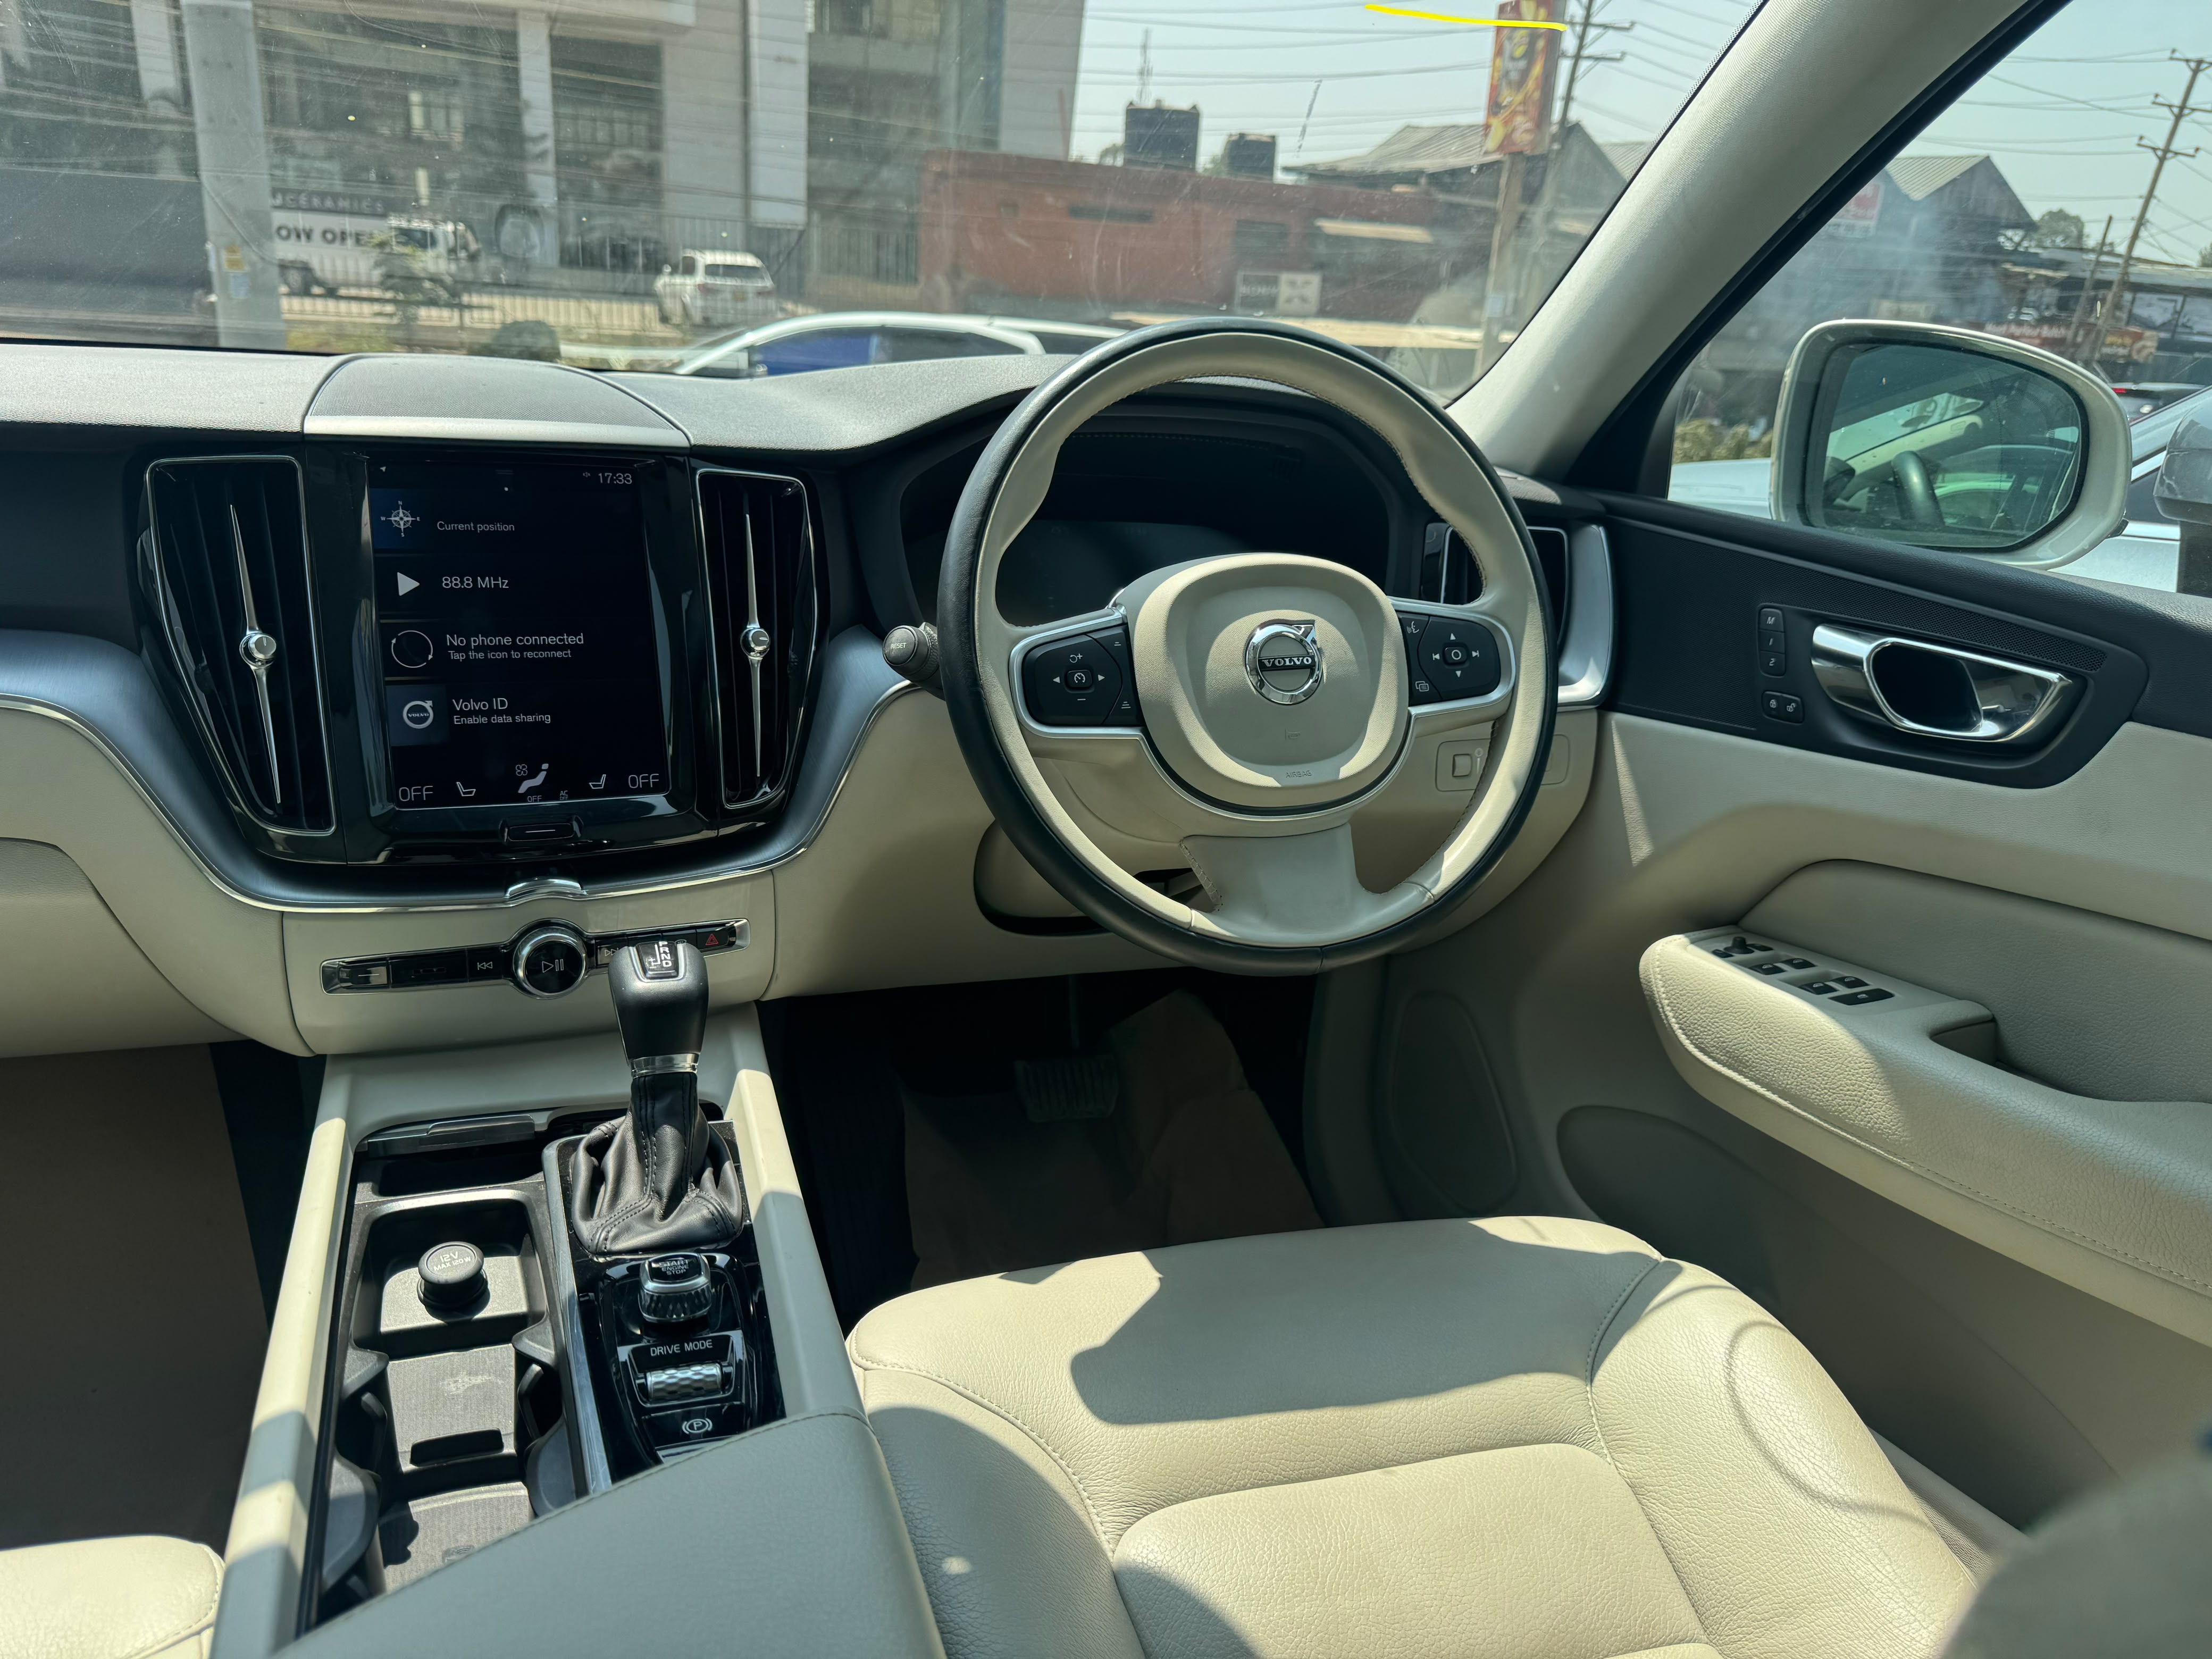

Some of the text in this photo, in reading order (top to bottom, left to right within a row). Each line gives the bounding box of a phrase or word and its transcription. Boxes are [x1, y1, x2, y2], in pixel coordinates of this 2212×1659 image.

[286, 192, 383, 212] CERAMICS
[276, 226, 370, 247] OW OPE
[598, 472, 633, 484] 17:33
[437, 521, 515, 533] Current position
[442, 576, 509, 589] 88.8 MHz
[447, 633, 584, 648] No phone connected
[448, 649, 572, 661] Tap the icon to reconnect
[1262, 657, 1312, 667] VOLVO
[453, 698, 508, 710] Volvo ID
[454, 713, 551, 724] Enable data sharing
[629, 774, 659, 788] OFF
[399, 786, 433, 801] OFF
[440, 1251, 458, 1262] 12V
[650, 1339, 713, 1356] DRIVE MODE
